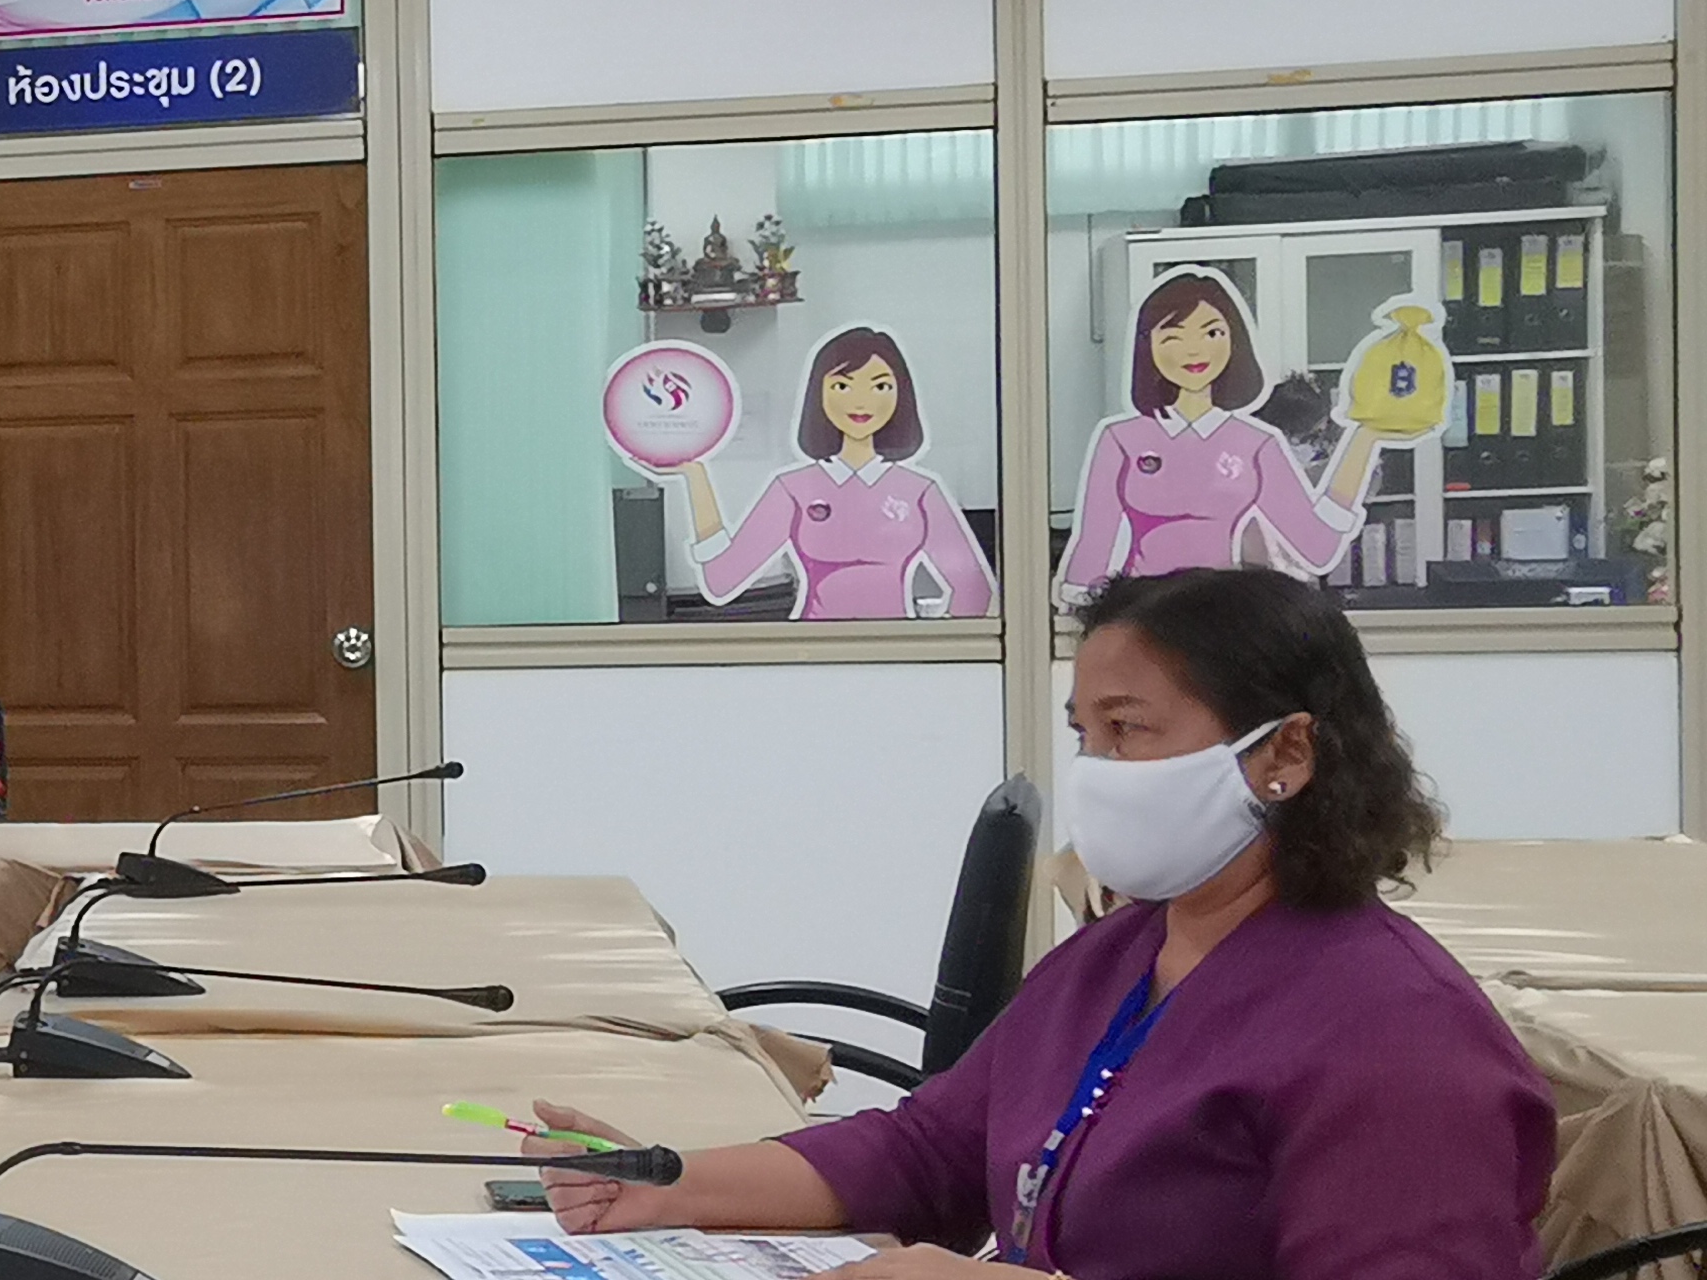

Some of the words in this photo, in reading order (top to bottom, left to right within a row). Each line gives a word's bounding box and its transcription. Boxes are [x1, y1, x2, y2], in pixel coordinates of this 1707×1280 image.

[7, 60, 196, 107] ห้องประชุม
[210, 57, 263, 99] (2)
